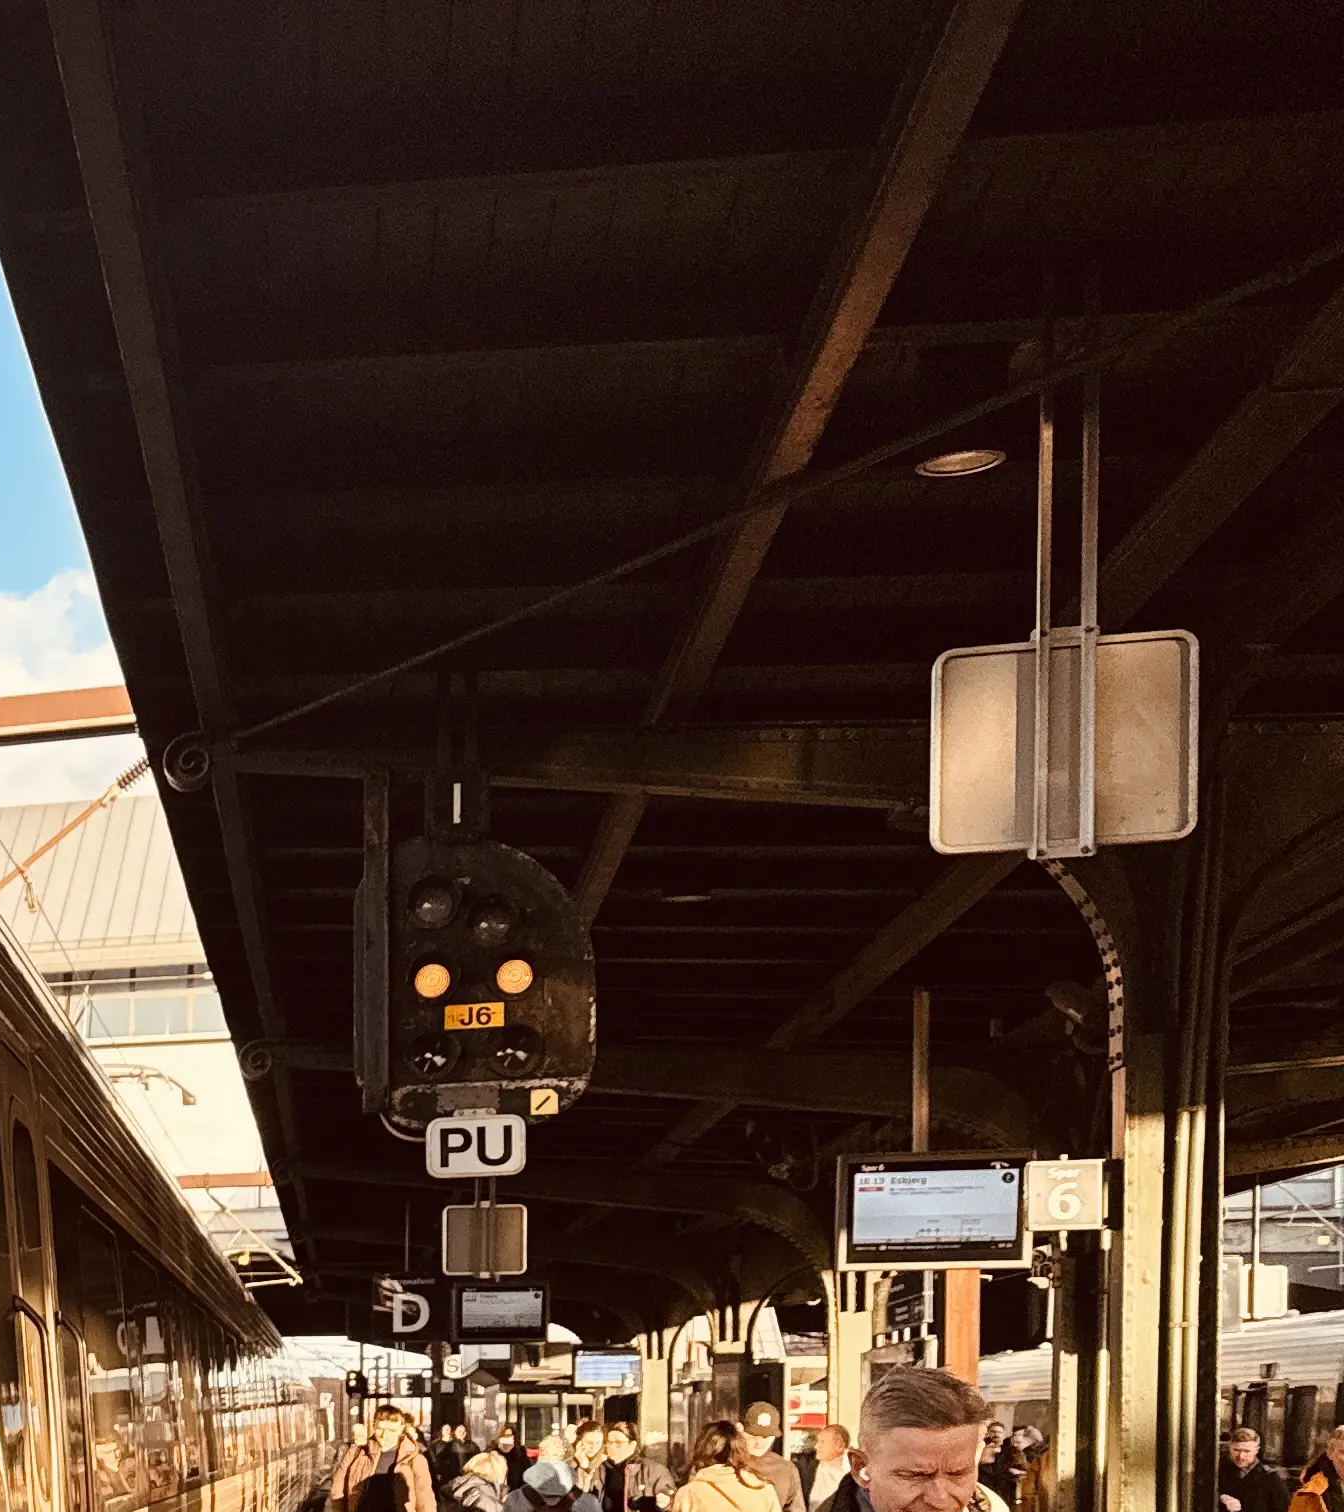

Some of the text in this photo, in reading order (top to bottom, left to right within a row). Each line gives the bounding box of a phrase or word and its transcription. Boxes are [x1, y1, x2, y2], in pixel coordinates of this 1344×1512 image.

[459, 1006, 493, 1026] J6
[439, 1124, 513, 1168] PU
[1048, 1181, 1082, 1220] 6
[392, 1293, 430, 1333] D
